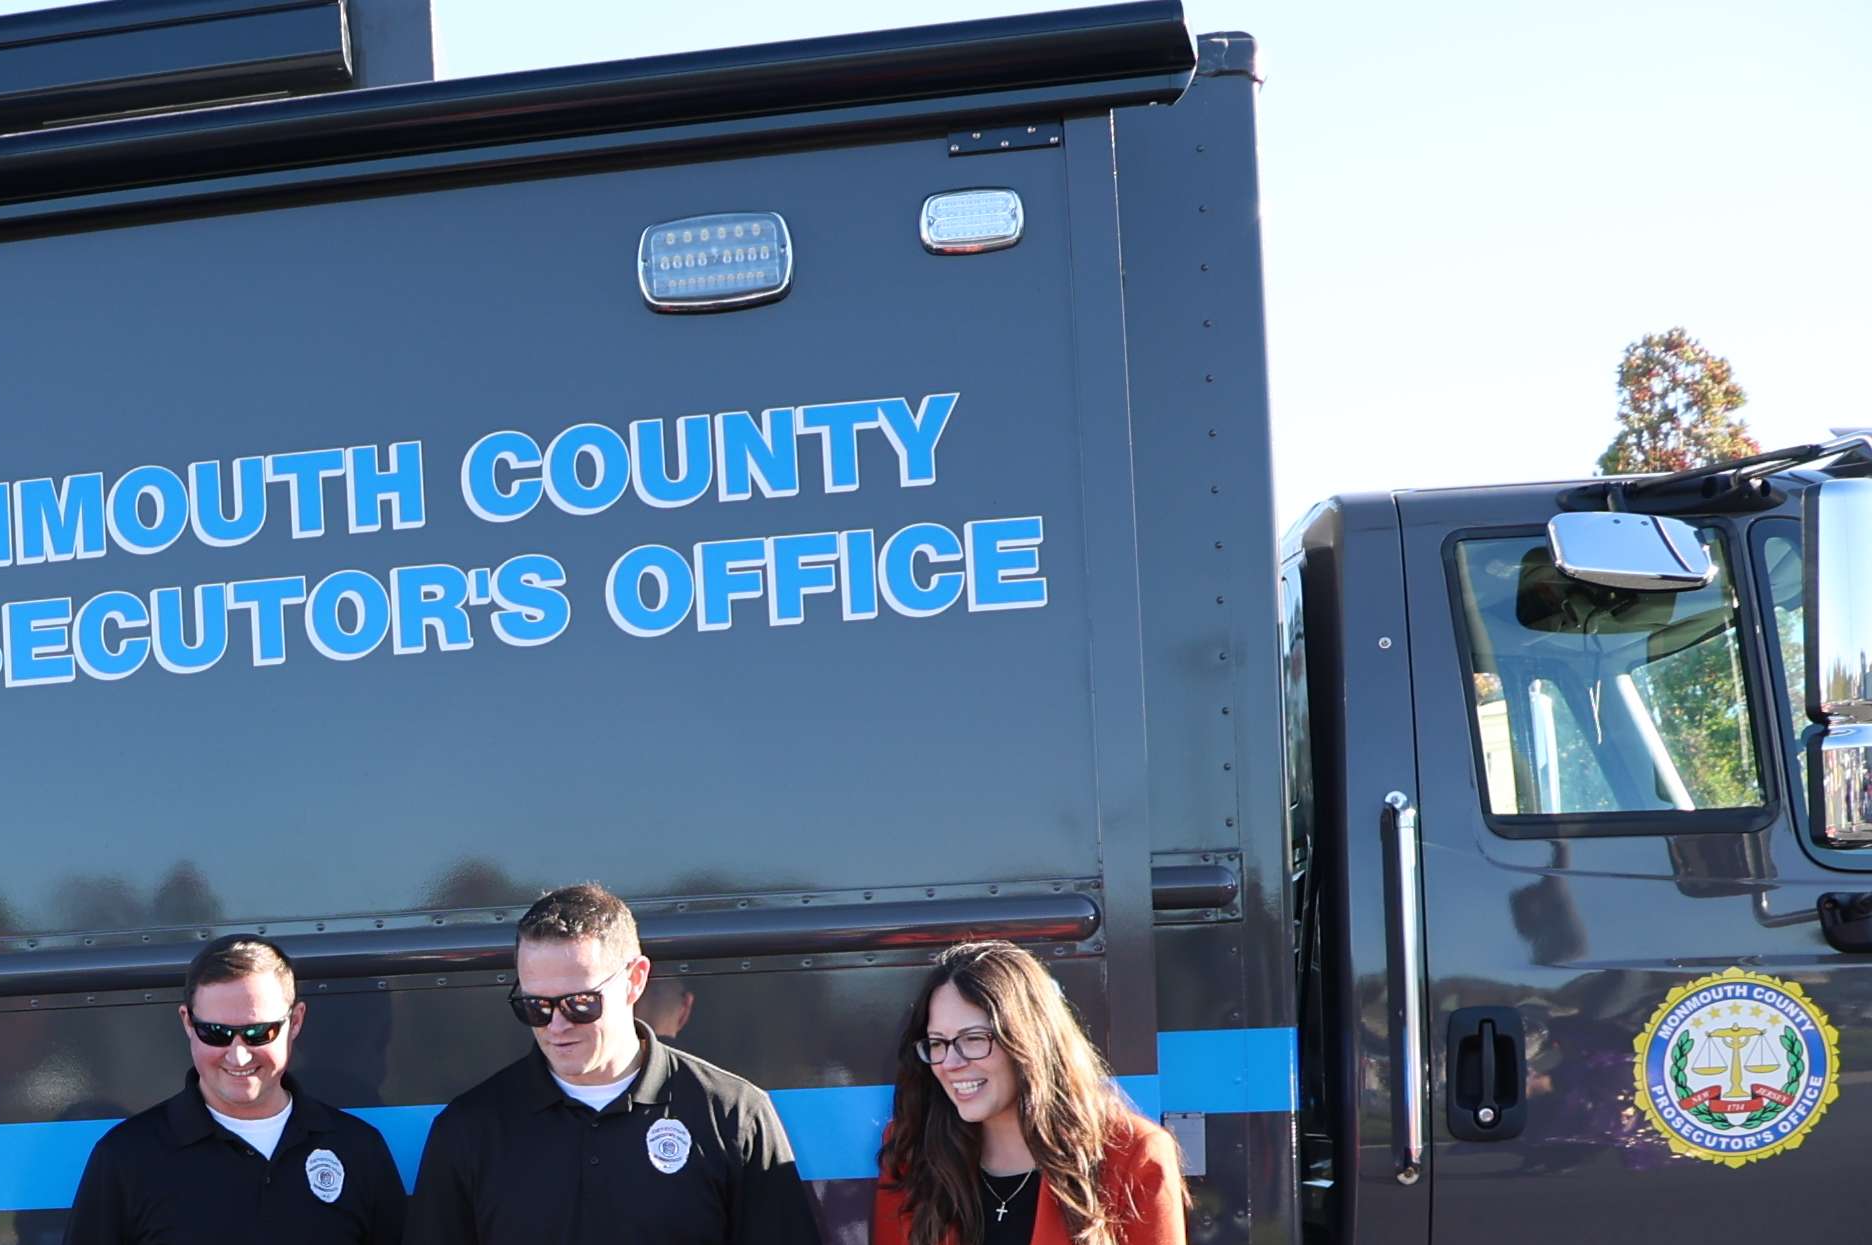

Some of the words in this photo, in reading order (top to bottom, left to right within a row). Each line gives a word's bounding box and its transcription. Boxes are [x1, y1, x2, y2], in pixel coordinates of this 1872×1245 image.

[461, 393, 960, 522] COUNTY
[605, 516, 1048, 638] OFFICE
[1657, 985, 1748, 1040] MONMOUTH
[1752, 987, 1815, 1032] COUNTY
[1651, 1084, 1774, 1150] PROSECUTOR'S
[1778, 1076, 1823, 1134] OFFICE
